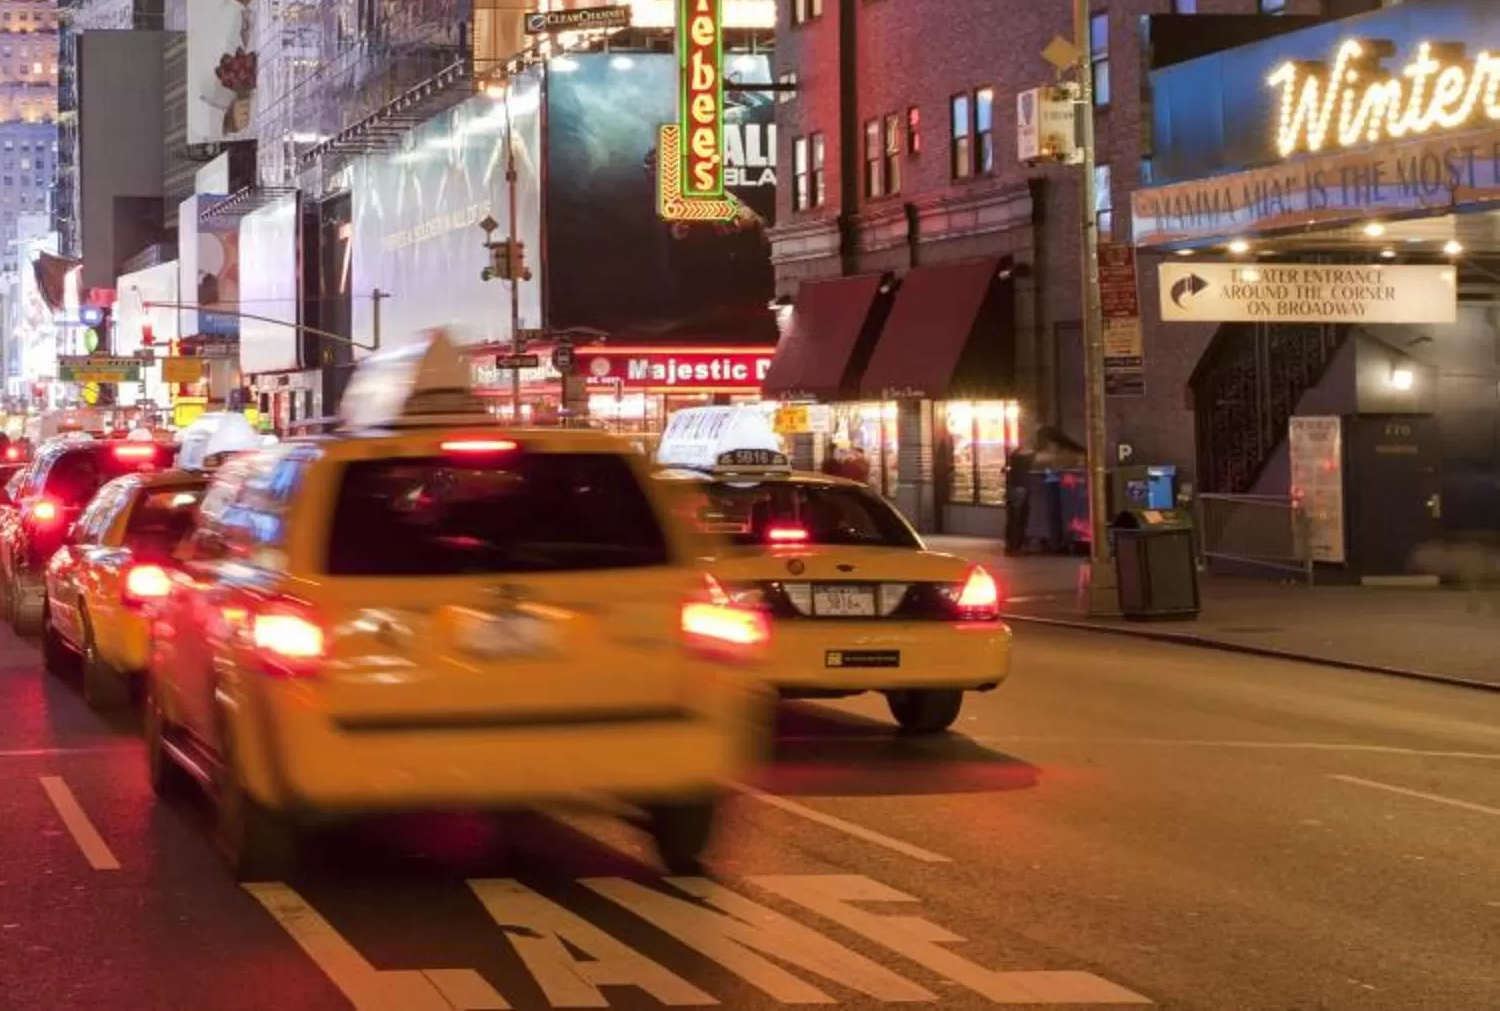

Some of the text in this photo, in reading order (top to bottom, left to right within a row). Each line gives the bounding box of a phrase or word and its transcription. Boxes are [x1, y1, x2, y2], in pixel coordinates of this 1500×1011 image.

[1267, 38, 1500, 159] Winter
[1305, 170, 1329, 212] IS
[1339, 160, 1388, 207] THE
[1396, 146, 1478, 199] MOST
[1230, 268, 1383, 284] TATER ENTRANCE
[1220, 284, 1396, 301] AROUND THE CORNER
[1247, 300, 1367, 317] ON BROADWAY
[627, 358, 747, 383] Majestic
